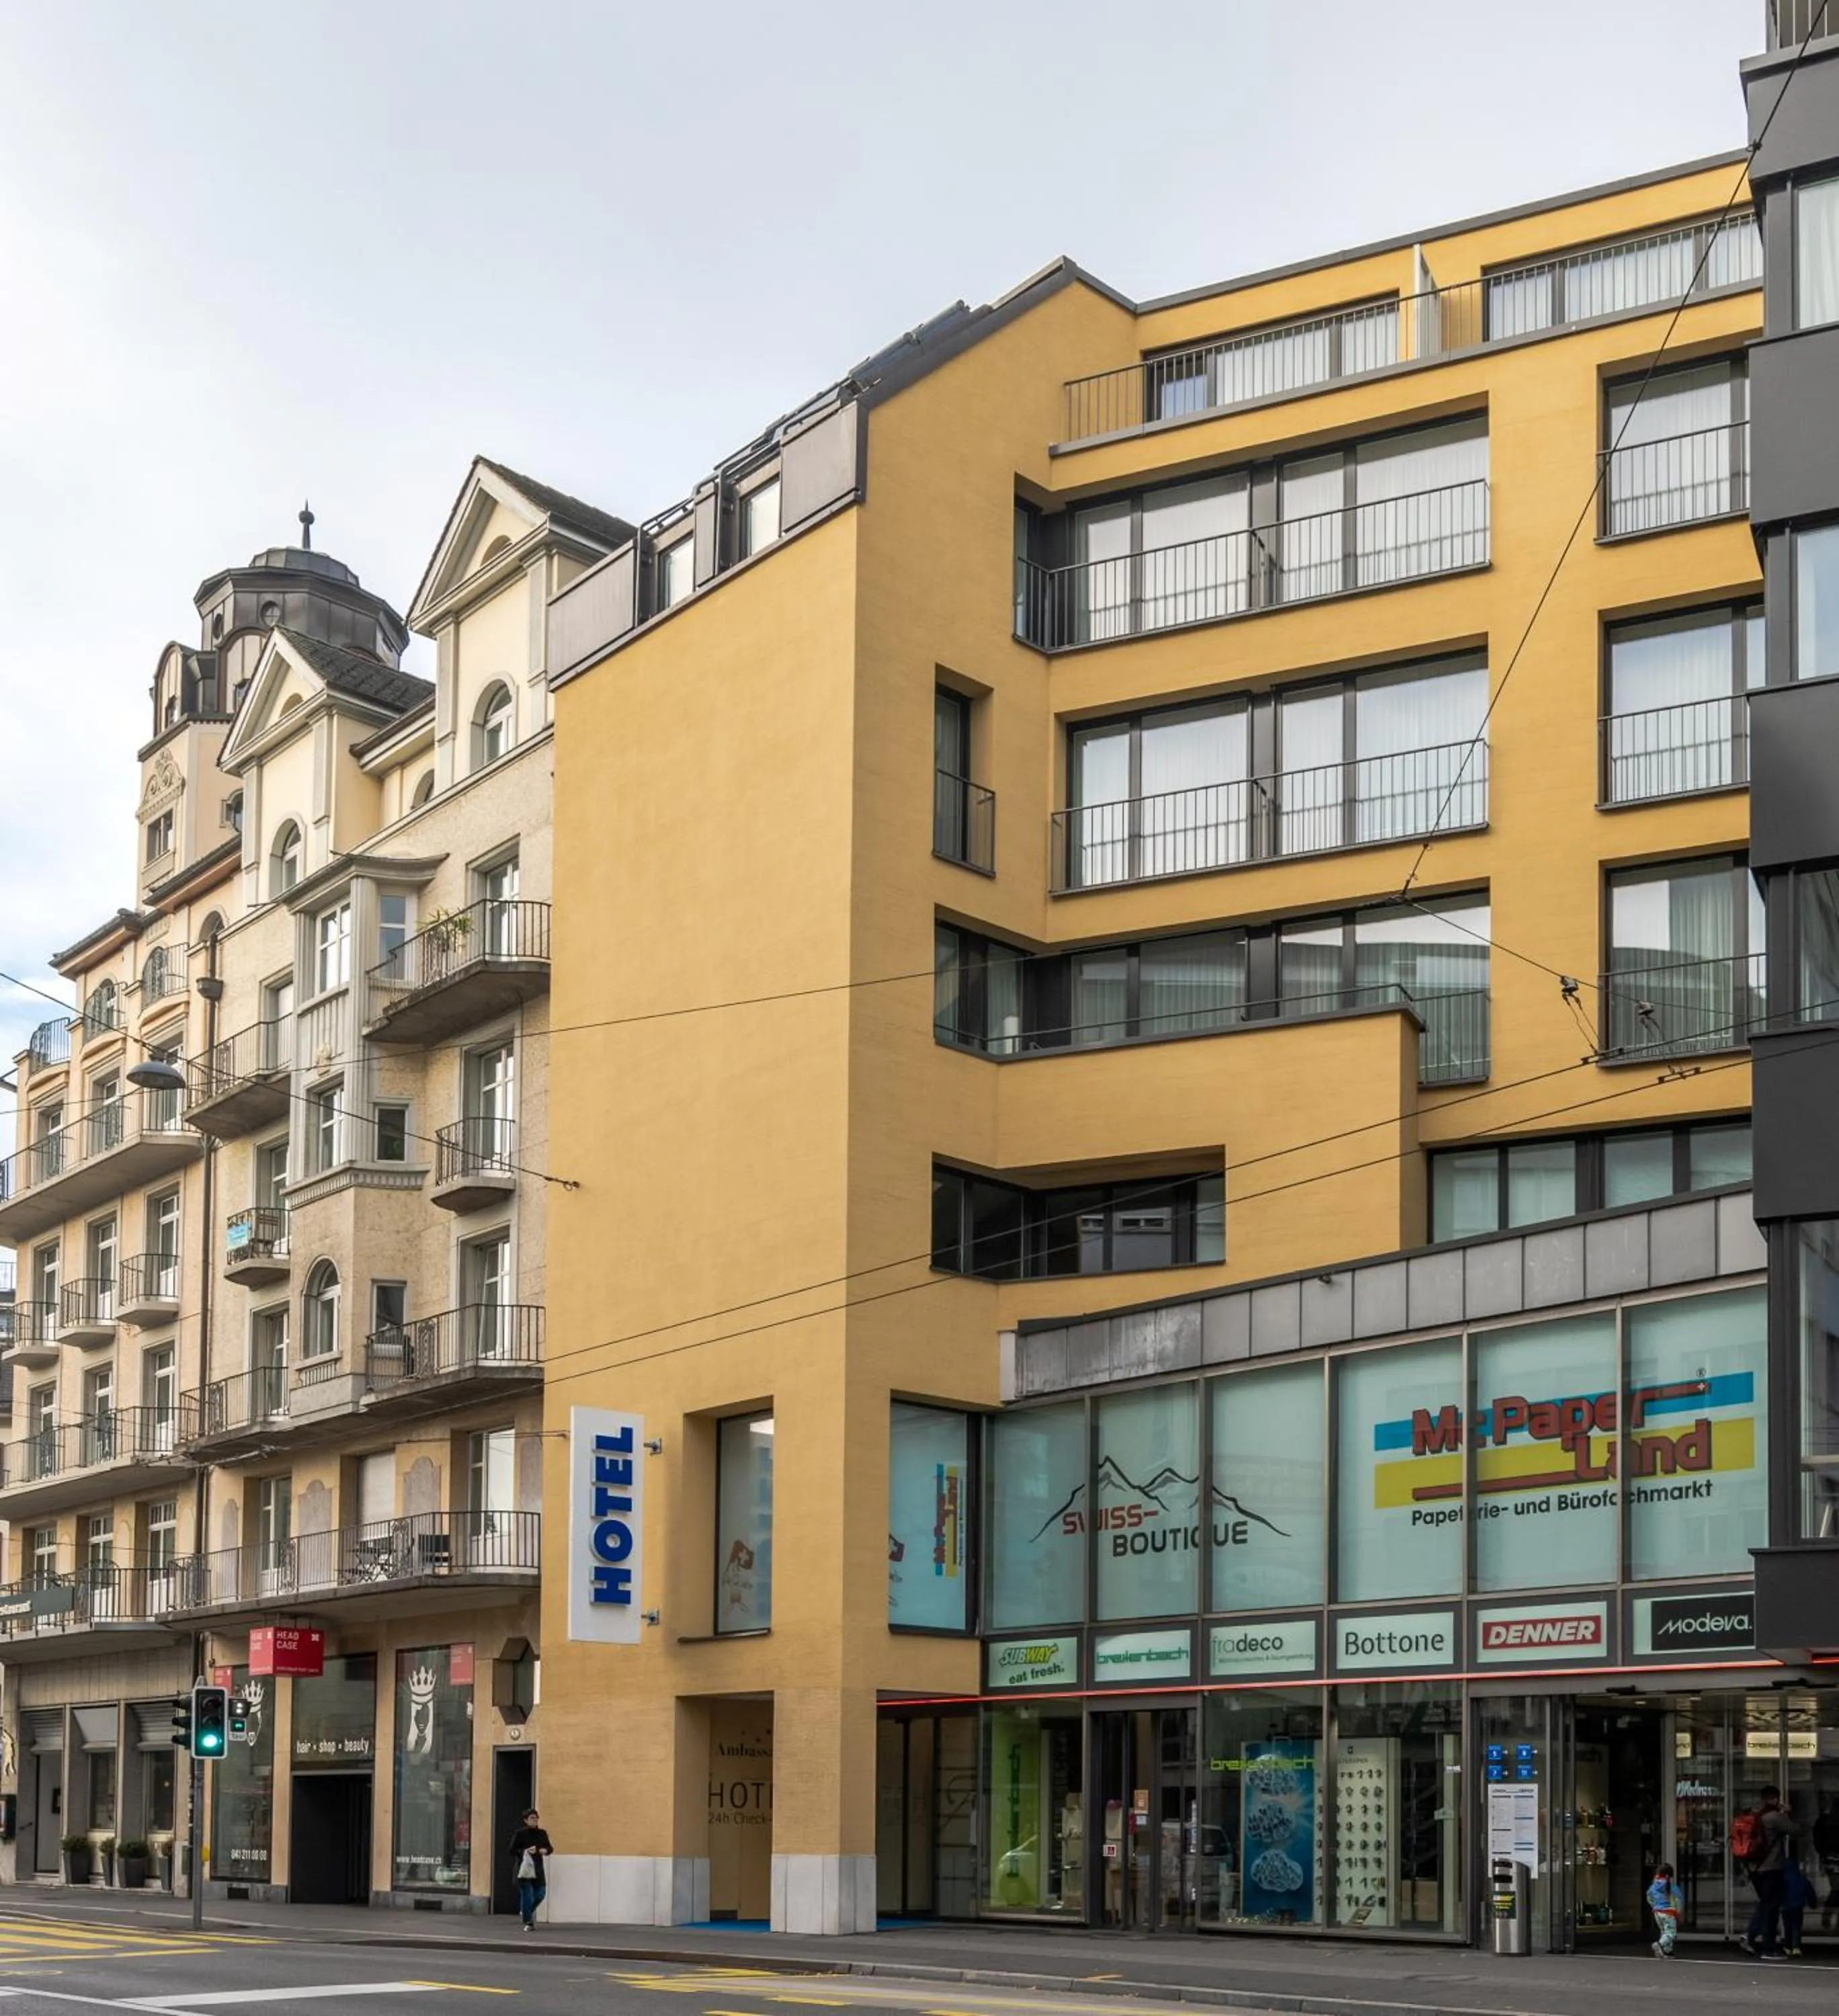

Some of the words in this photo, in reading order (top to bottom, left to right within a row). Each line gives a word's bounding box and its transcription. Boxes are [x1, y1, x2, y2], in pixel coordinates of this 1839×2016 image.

[590, 1426, 634, 1605] HOTEL
[1412, 1502, 1509, 1527] Papetrie-
[1514, 1496, 1550, 1515] und
[1488, 1620, 1595, 1645] DENNER
[1657, 1613, 1752, 1635] Modeva.
[276, 1631, 299, 1640] HEAD
[276, 1640, 298, 1650] CASE
[1345, 1632, 1444, 1655] Bottone
[999, 1642, 1059, 1667] SUBWAY
[1009, 1671, 1027, 1684] eat
[1030, 1663, 1065, 1679] fresh.
[319, 1738, 335, 1755] shop
[343, 1737, 369, 1753] beauty
[708, 1782, 772, 1809] HOT
[708, 1813, 729, 1824] 24h
